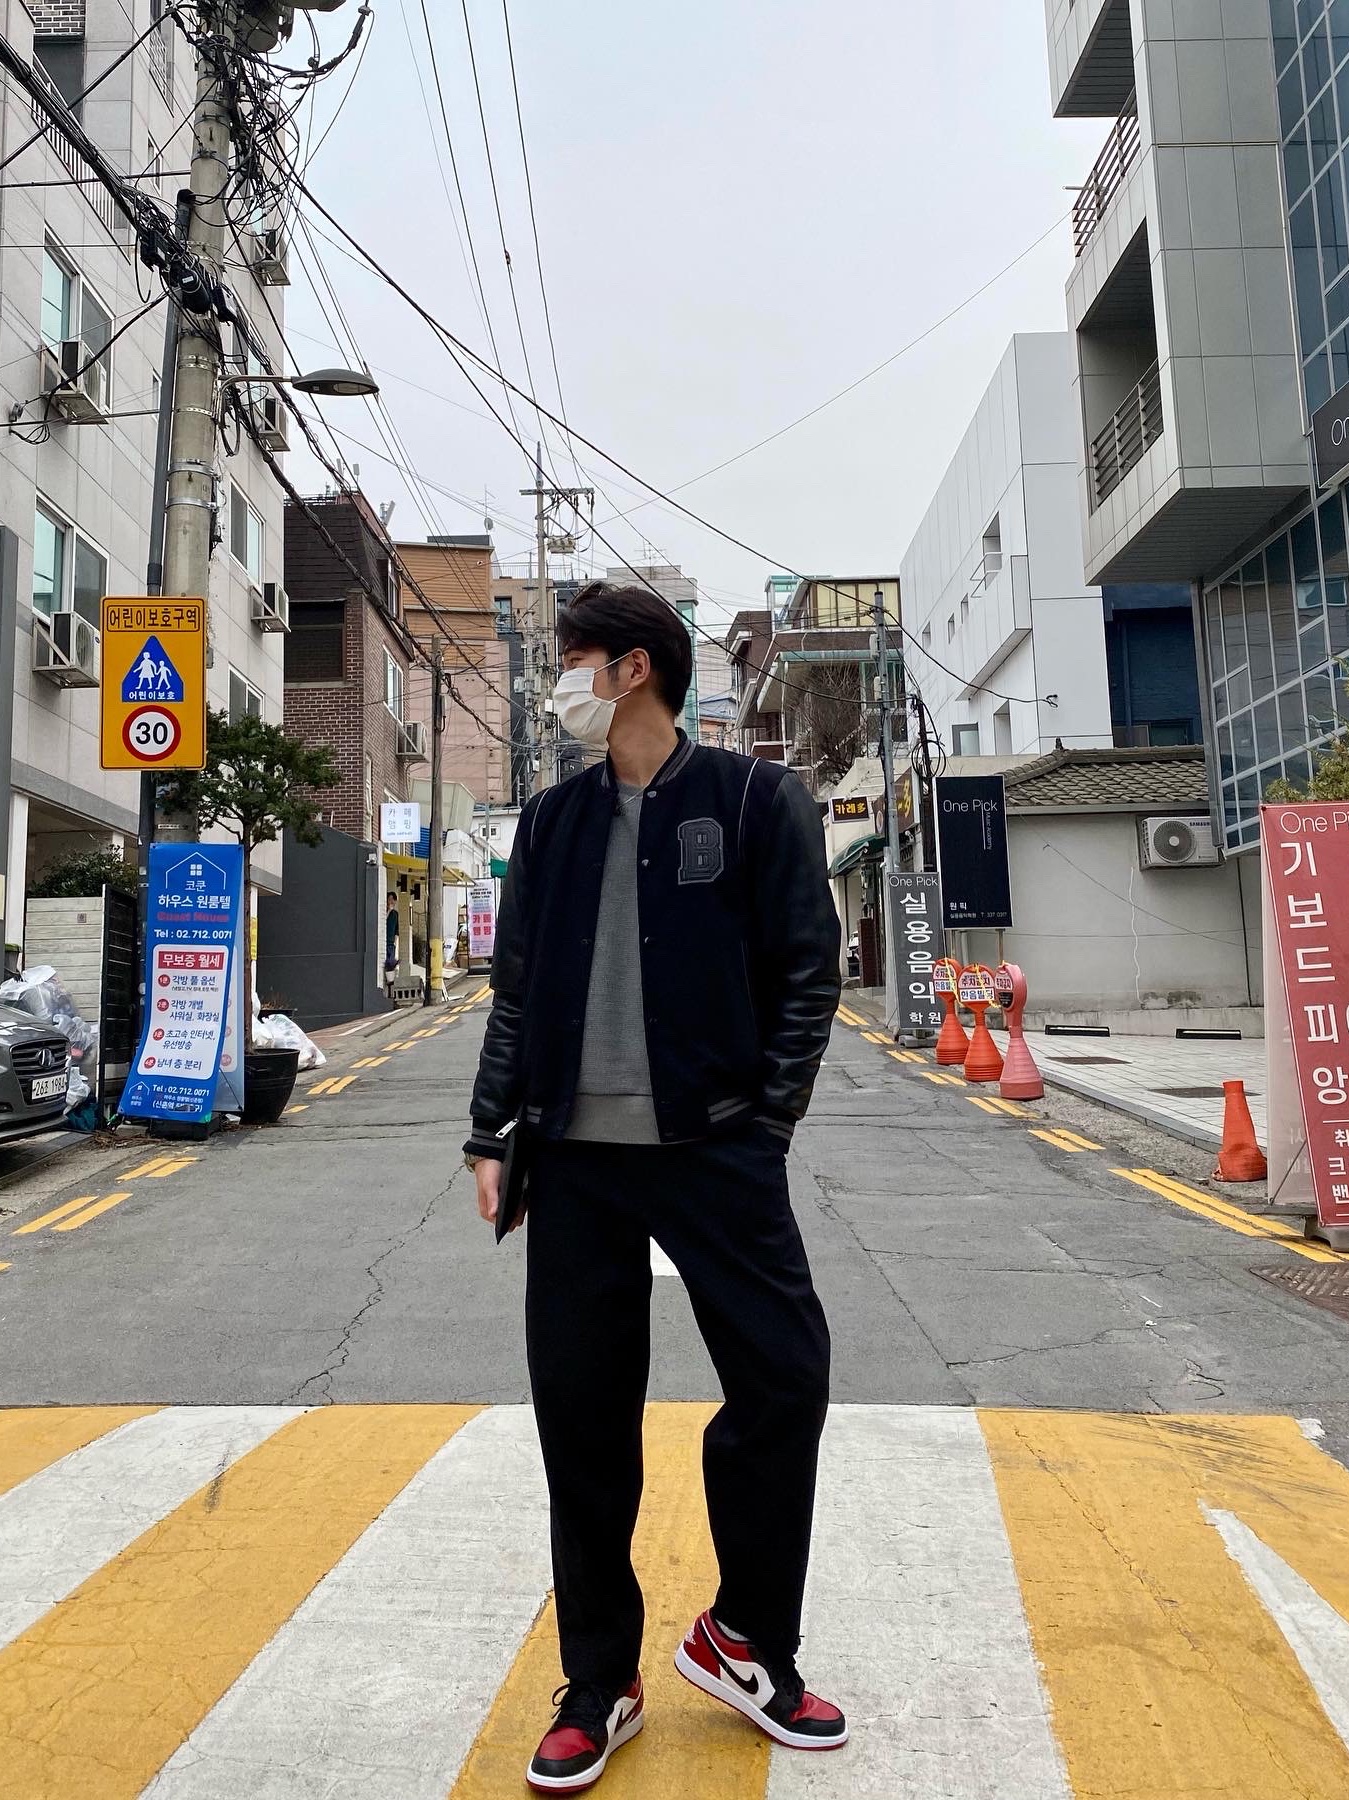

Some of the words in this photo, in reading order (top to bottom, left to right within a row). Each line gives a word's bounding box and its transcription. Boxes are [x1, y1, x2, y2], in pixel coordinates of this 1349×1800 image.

[109, 607, 197, 629] 어린이보호구역
[128, 691, 176, 700] 어린이보호
[135, 722, 168, 745] 30
[943, 799, 969, 813] One
[972, 799, 998, 813] Pick
[1280, 811, 1328, 834] One
[677, 817, 724, 886] B
[184, 880, 207, 893] 코쿤
[889, 875, 913, 887] One
[916, 876, 938, 887] Pick
[158, 894, 194, 909] 하우스
[196, 895, 231, 910] 원룸텔
[153, 928, 169, 938] Tel
[900, 891, 937, 1005] 실용음악
[162, 953, 196, 968] 무보증
[198, 954, 220, 968] 월세
[172, 975, 188, 986] 각방
[200, 975, 216, 986] 옵션
[170, 1000, 187, 1010] 각방
[197, 1011, 220, 1023] 화장실
[165, 1030, 187, 1040] 초고속
[162, 1040, 193, 1051] 유선방송
[157, 1058, 172, 1068] 남녀
[184, 1060, 202, 1071] 분리
